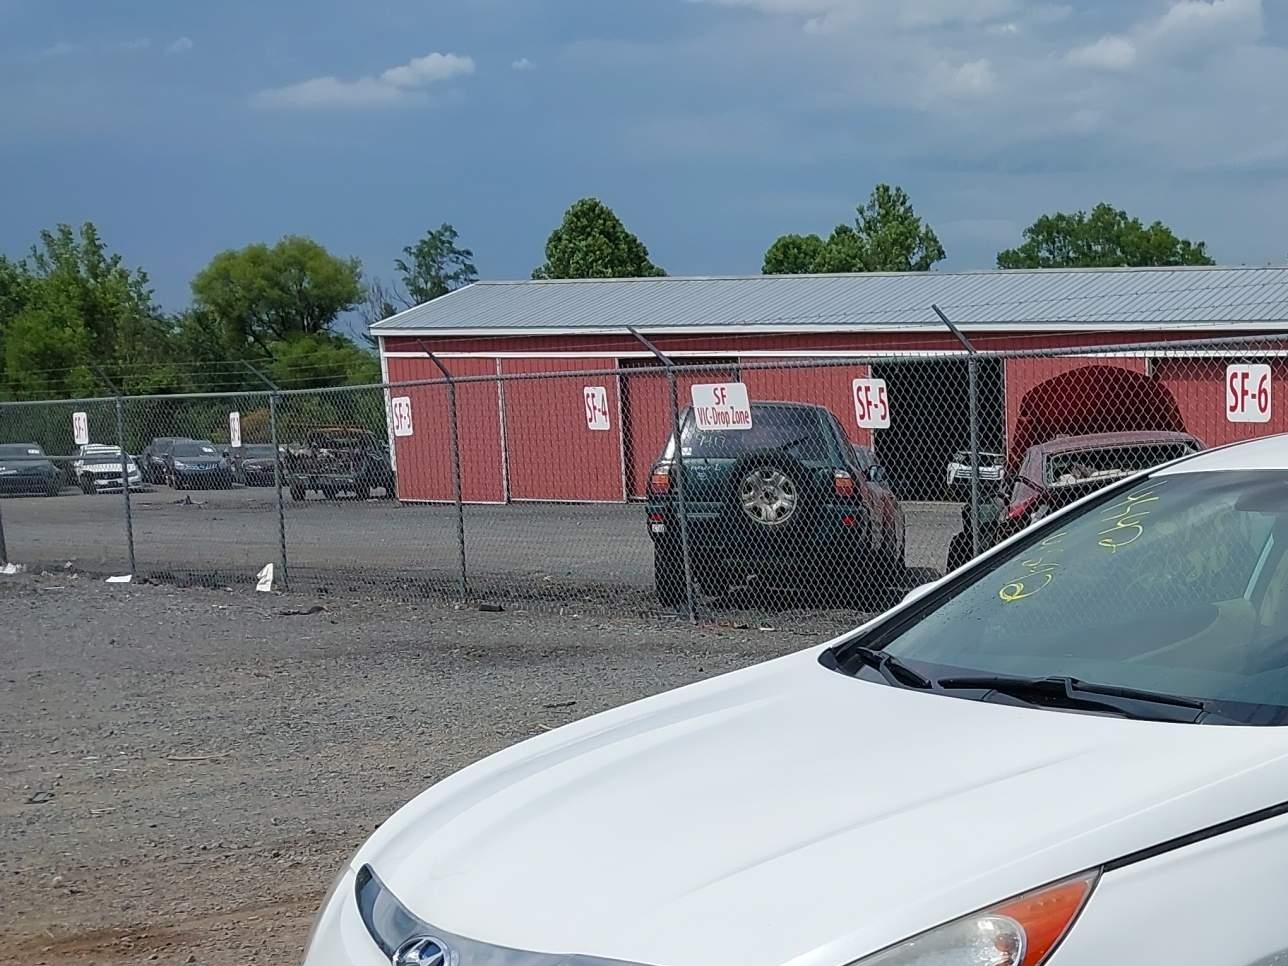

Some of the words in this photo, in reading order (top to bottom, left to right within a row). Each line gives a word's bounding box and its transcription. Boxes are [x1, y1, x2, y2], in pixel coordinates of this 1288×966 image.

[713, 387, 727, 406] SF
[856, 385, 887, 421] SF-5
[1229, 371, 1268, 413] SF-6
[394, 402, 411, 430] SF-3
[586, 392, 608, 423] SF-4
[697, 406, 730, 428] VIC-Drop
[730, 406, 750, 425] Zone
